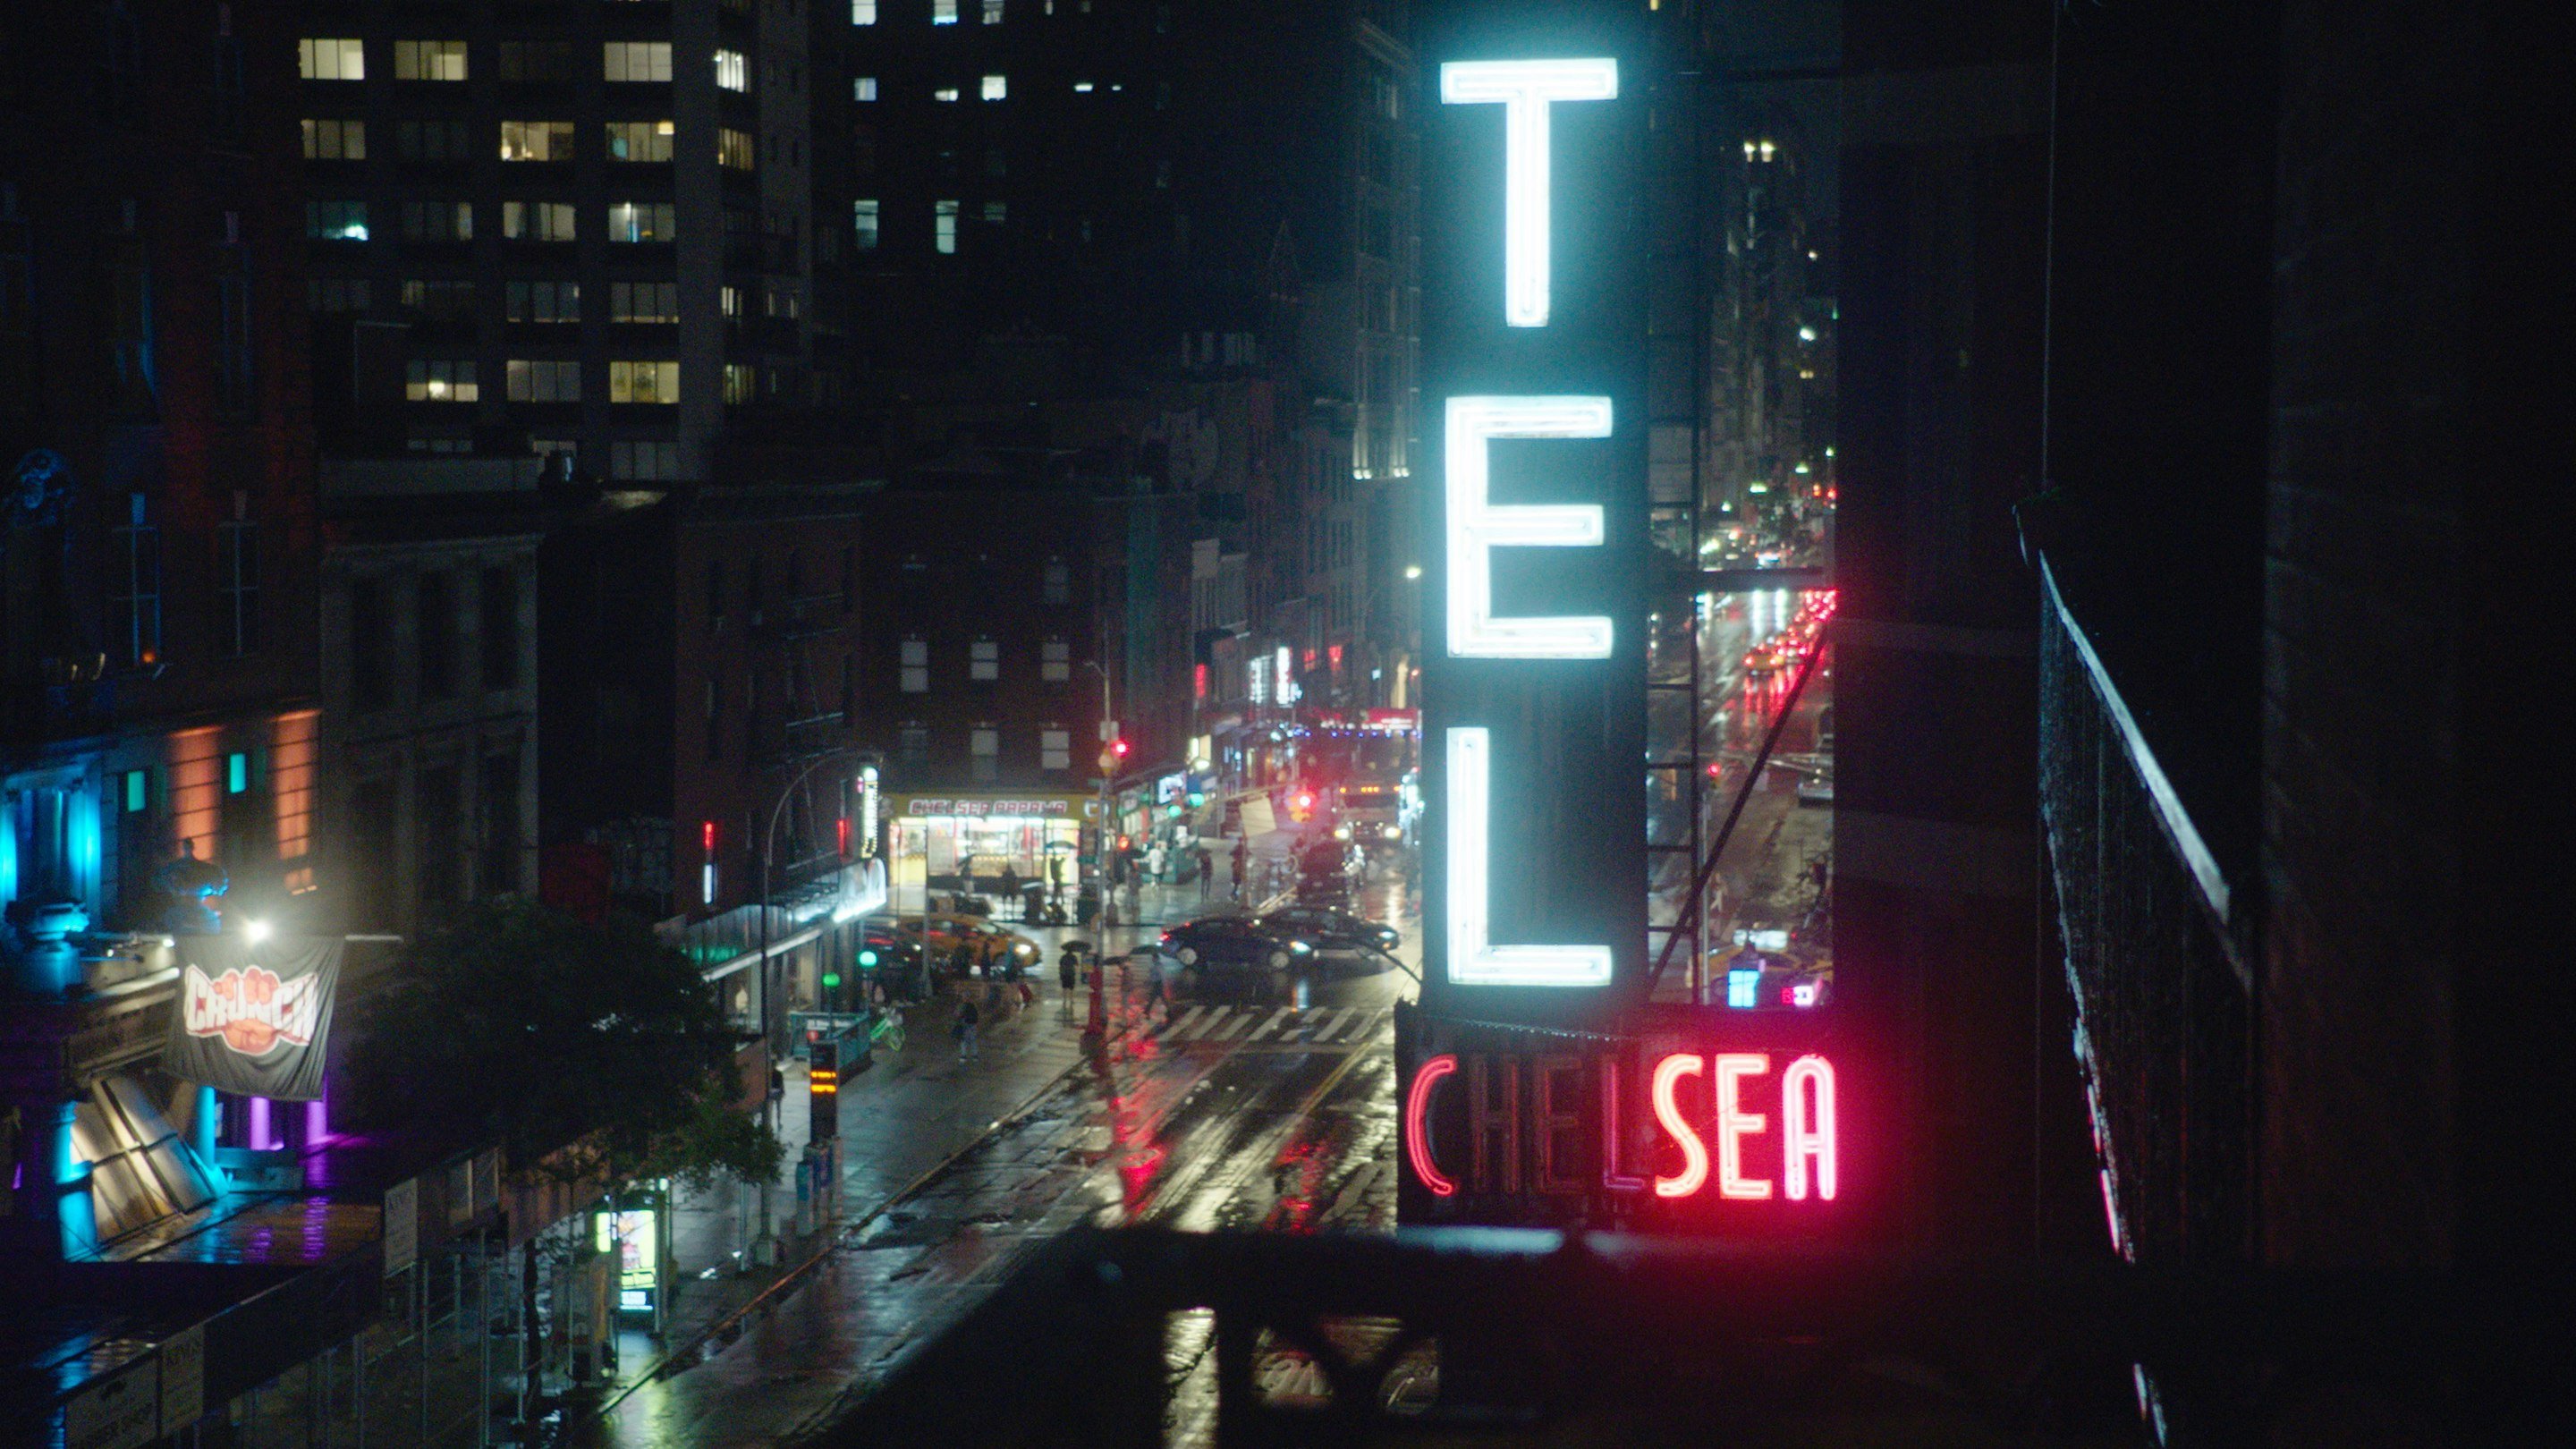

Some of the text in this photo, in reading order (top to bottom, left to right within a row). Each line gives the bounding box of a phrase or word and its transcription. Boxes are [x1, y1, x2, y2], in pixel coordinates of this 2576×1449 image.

[1440, 58, 1619, 987] TEL
[909, 800, 990, 815] CHELSEA
[185, 967, 317, 1043] CRUNCH
[1407, 1052, 1838, 1201] CHELSEA
